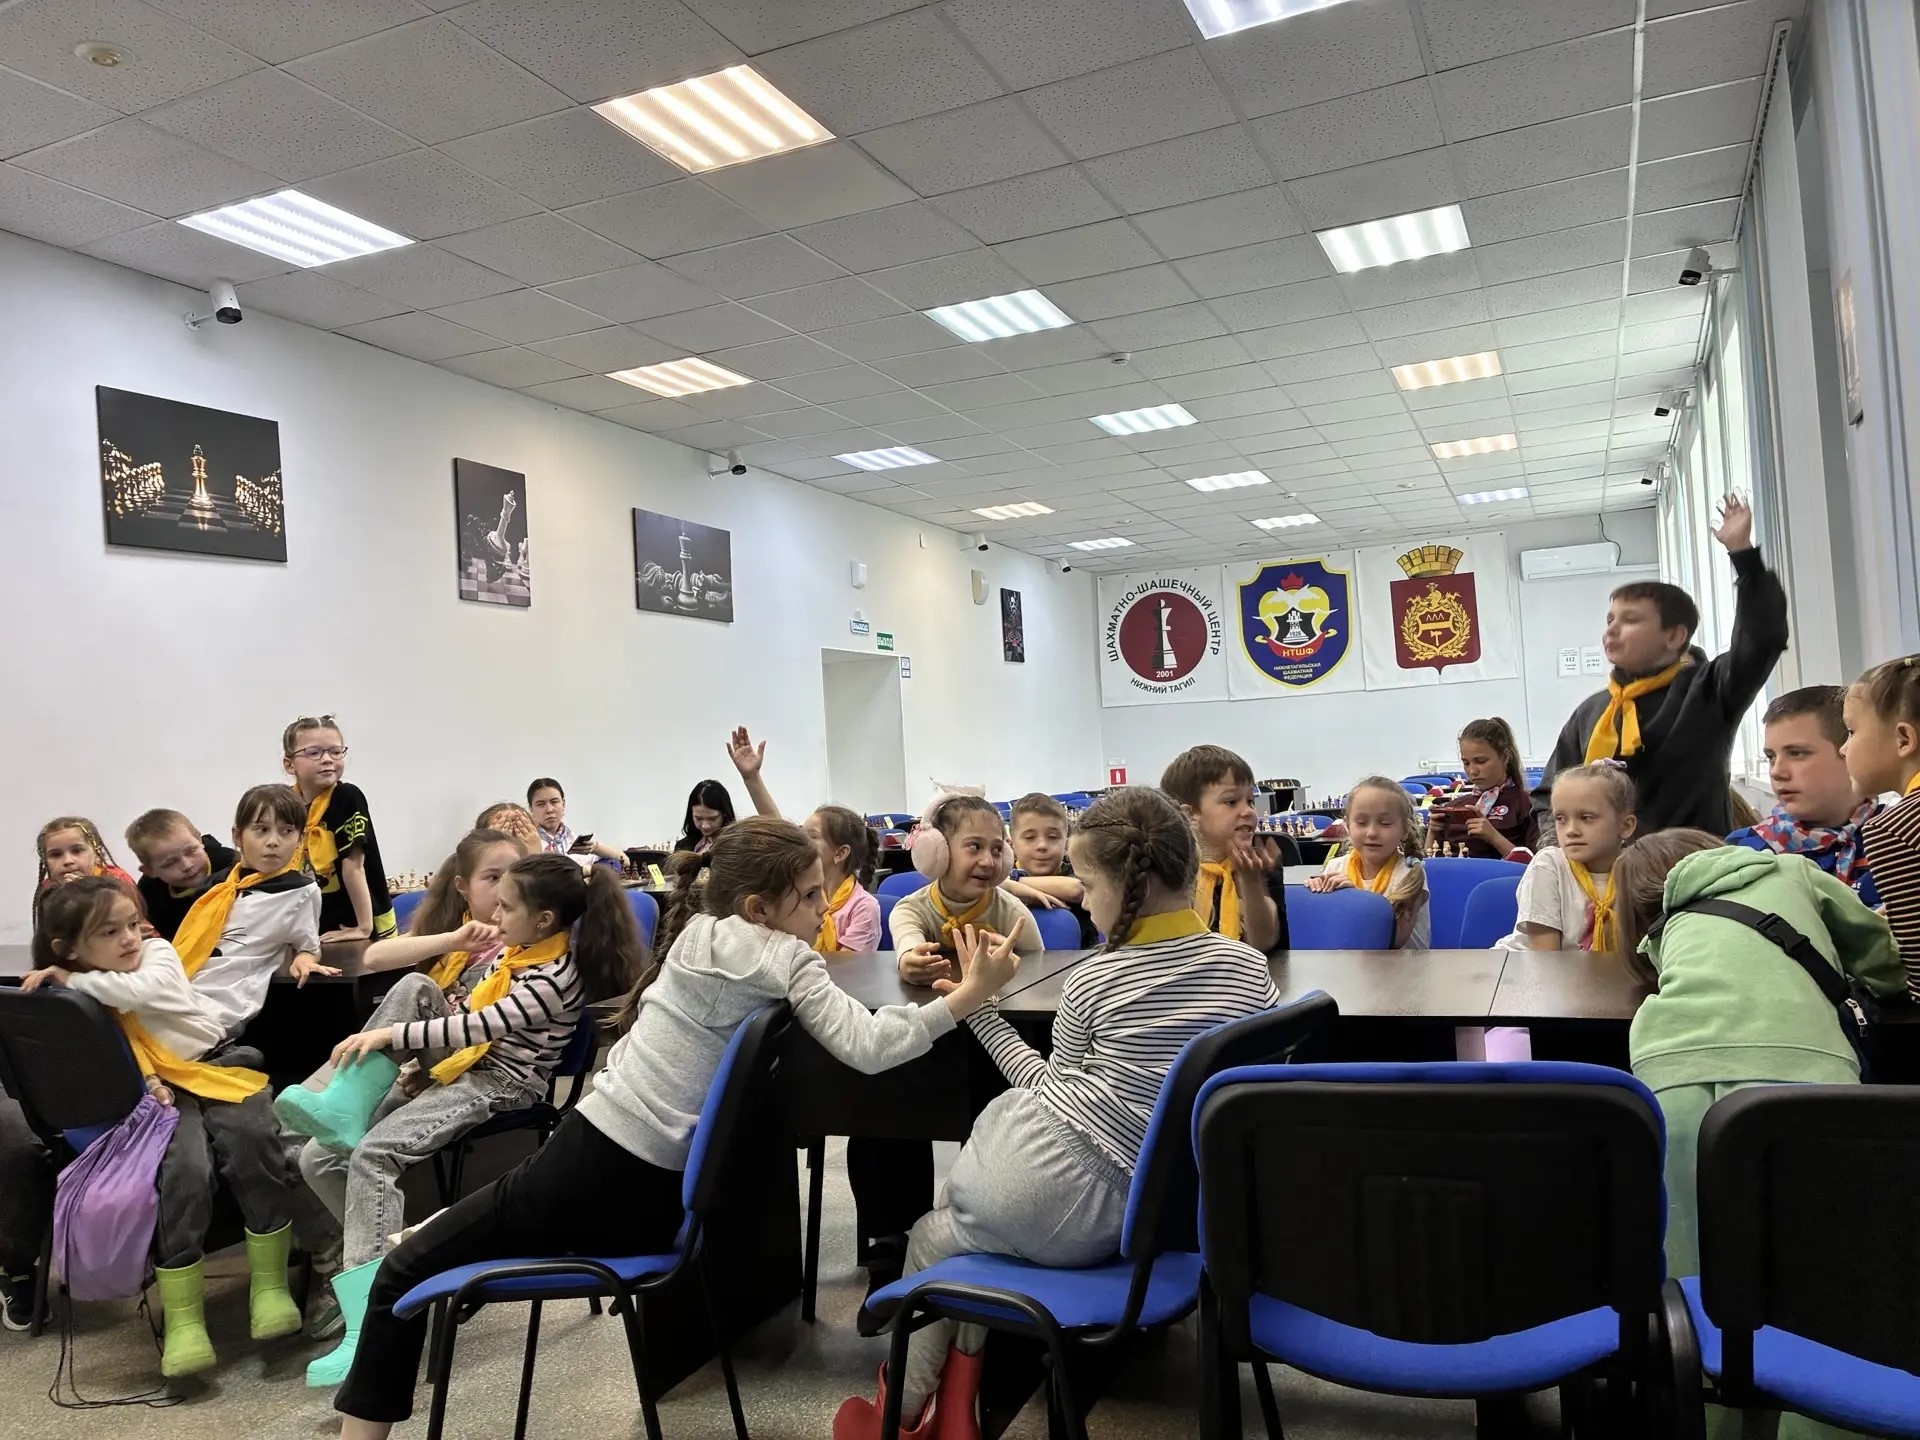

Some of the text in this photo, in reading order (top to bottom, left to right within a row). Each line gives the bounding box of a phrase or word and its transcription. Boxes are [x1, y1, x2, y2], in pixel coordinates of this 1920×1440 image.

[1107, 579, 1221, 662] ШАХМАТНО-ШАШЕЧНЫЙ ЦЕНТР
[1282, 648, 1314, 657] НТШФ
[1273, 662, 1321, 671] НИЖНЕТАГИЛЬСКАЯ
[1156, 670, 1174, 678] 2001
[1130, 676, 1196, 694] НИЖНИЙ ТАГИЛ
